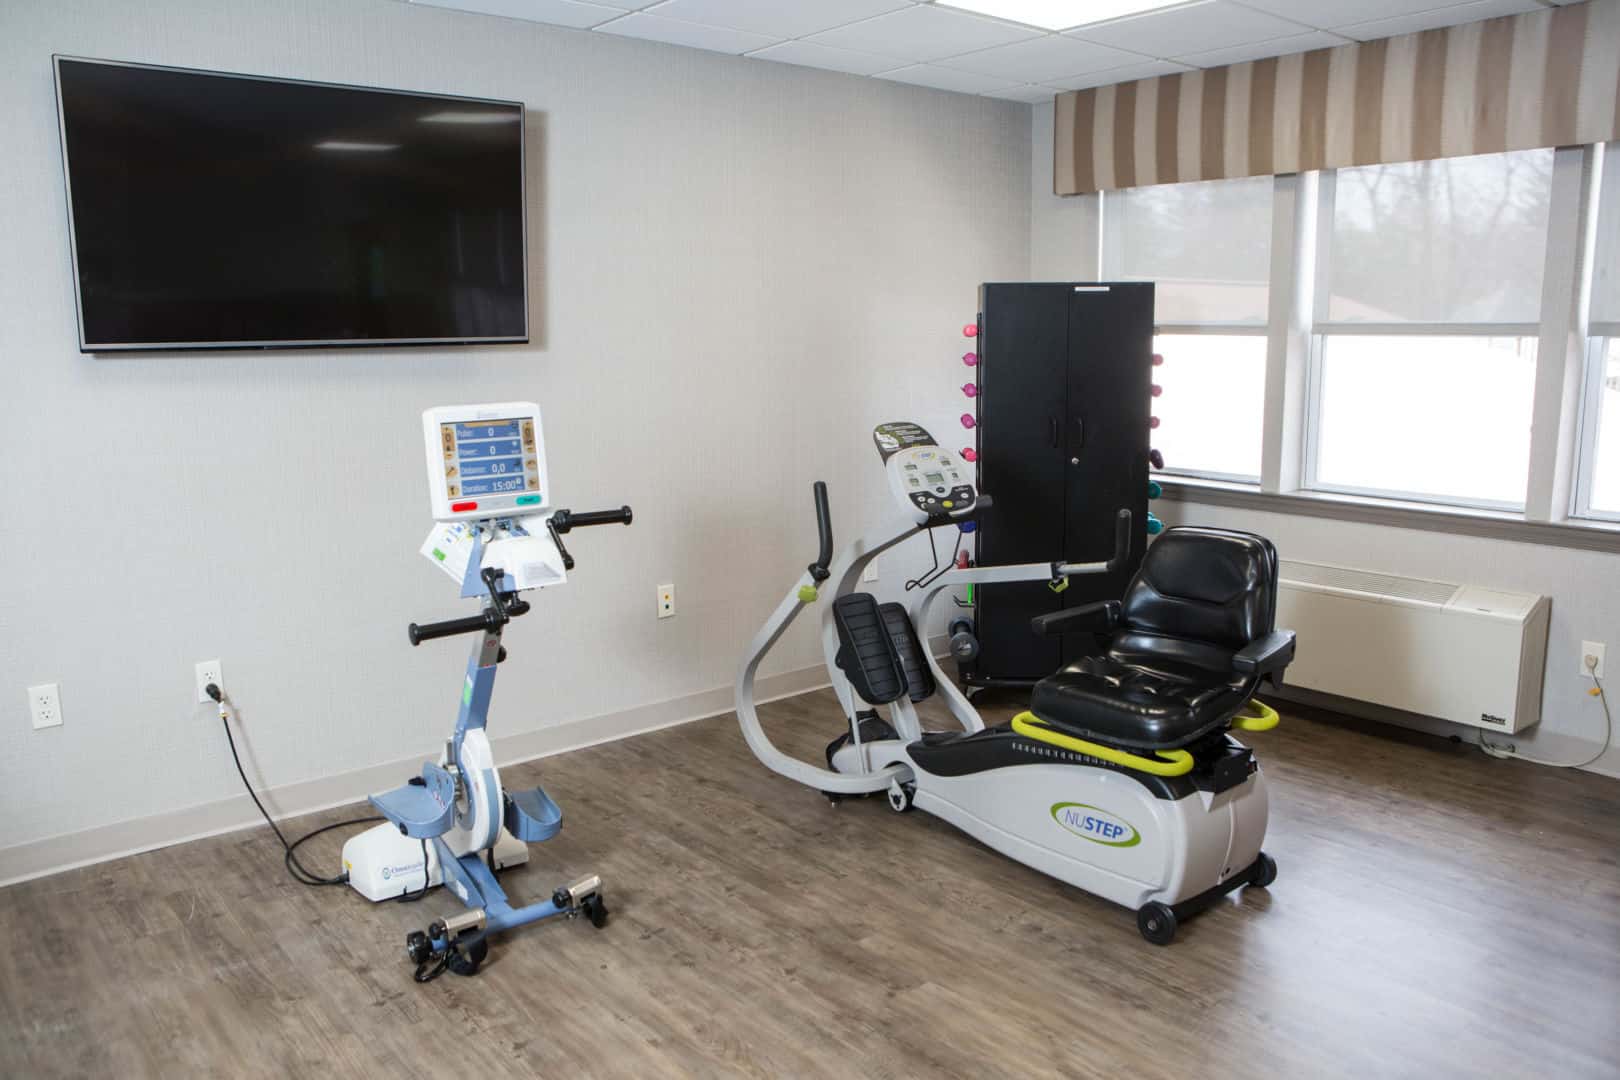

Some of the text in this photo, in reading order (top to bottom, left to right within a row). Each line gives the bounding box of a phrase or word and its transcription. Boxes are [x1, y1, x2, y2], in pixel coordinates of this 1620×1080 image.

[488, 427, 494, 437] 0
[490, 446, 496, 456] 0
[493, 480, 516, 491] 15:00
[1064, 810, 1125, 839] NUSTEP
